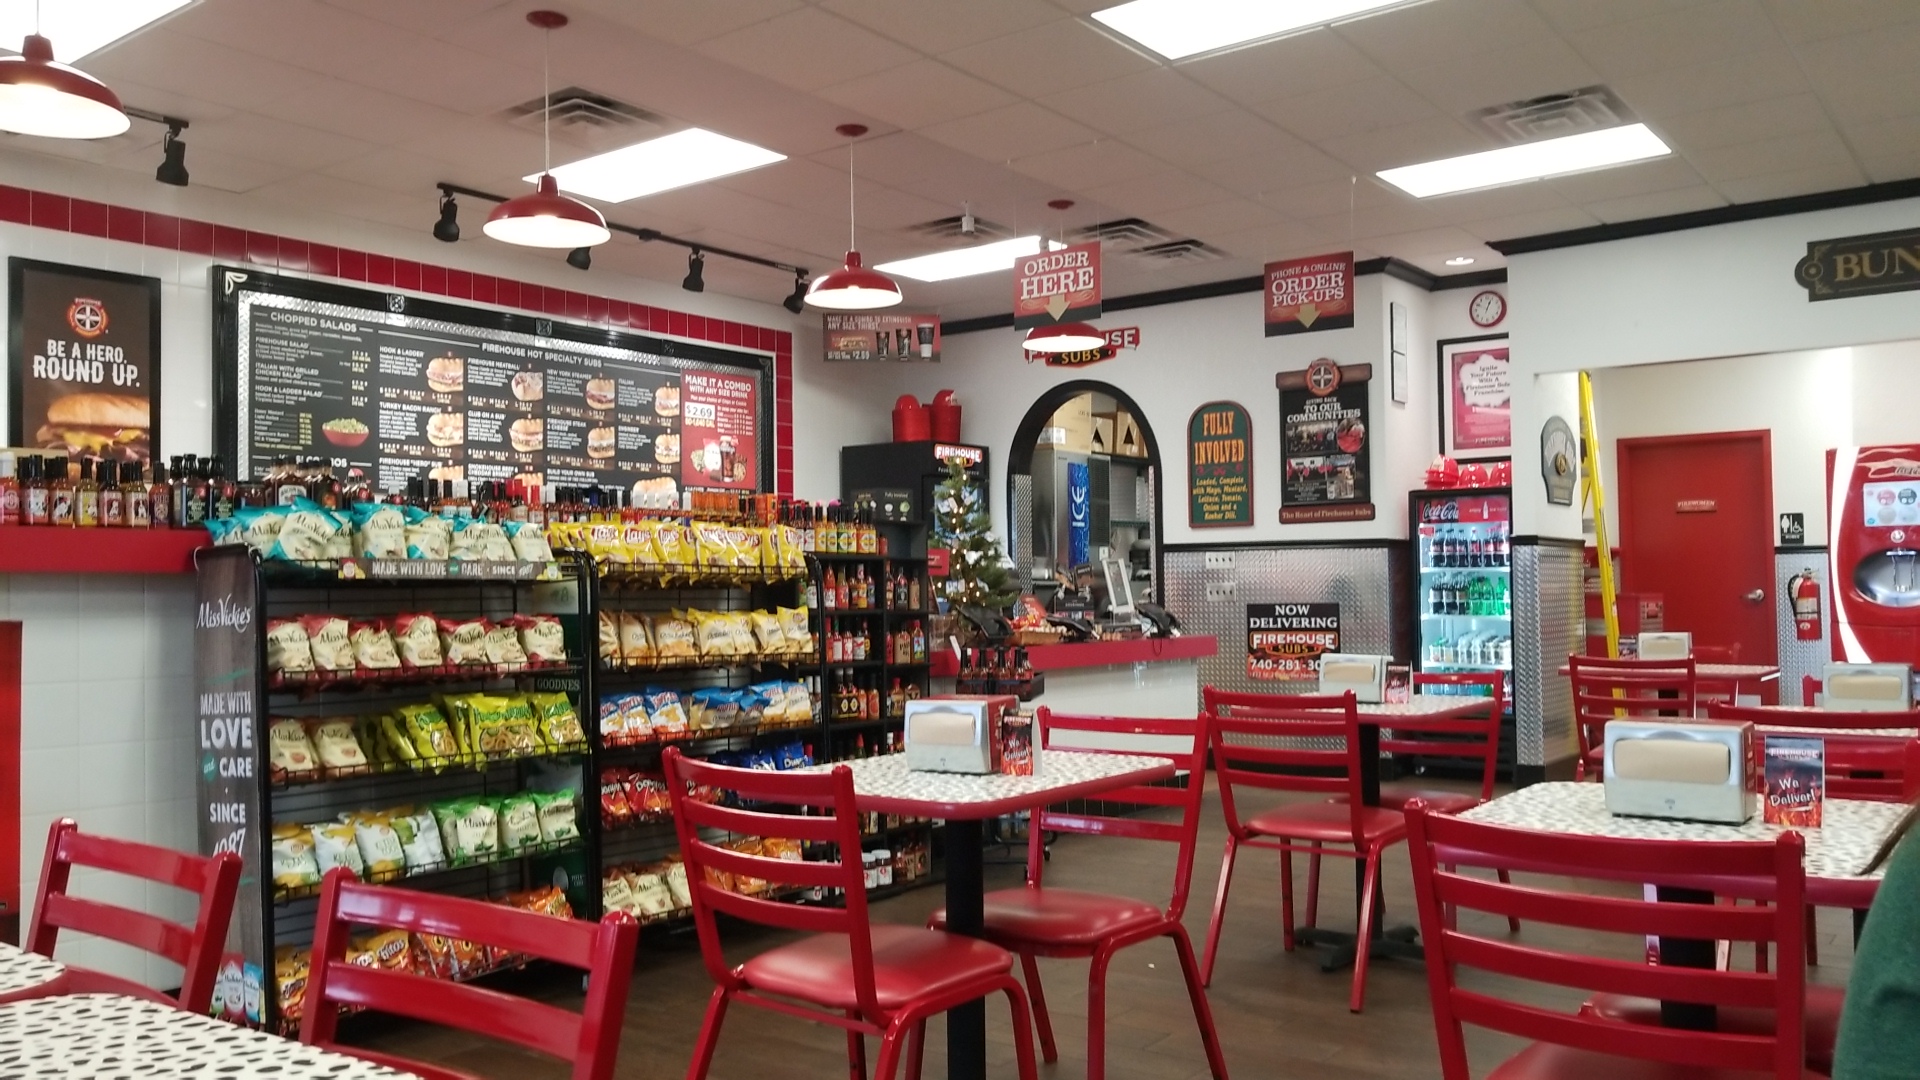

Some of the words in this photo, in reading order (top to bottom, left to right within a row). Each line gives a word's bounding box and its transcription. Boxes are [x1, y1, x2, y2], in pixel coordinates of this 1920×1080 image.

[1024, 251, 1089, 276] ORDER
[1271, 266, 1301, 280] PHONE
[1310, 262, 1346, 272] ONLINE
[1021, 267, 1094, 300] HERE
[1272, 272, 1344, 295] ORDER
[1272, 287, 1344, 307] PICK-UPS
[270, 312, 317, 327] CHOPPED
[320, 319, 357, 333] SALADS
[828, 322, 840, 330] ANY
[256, 336, 288, 346] FIREHOUSE
[47, 339, 66, 357] BE
[72, 342, 81, 360] A
[86, 344, 128, 364] HERO.
[380, 346, 396, 354] HOOK
[402, 349, 424, 358] LADDER
[482, 342, 526, 356] FIREHOUSE
[528, 349, 542, 359] HOT
[544, 352, 582, 365] SPECIALTY
[584, 357, 602, 368] SUBS
[1061, 348, 1100, 364] SUBS
[256, 362, 278, 370] ITALIAN
[295, 367, 319, 376] GRILLED
[468, 358, 494, 367] FIREHOUSE
[33, 355, 104, 384] ROUND
[112, 364, 140, 388] UP.
[685, 374, 707, 386] MAKE
[710, 378, 716, 387] IT
[717, 379, 723, 388] A
[724, 380, 751, 392] COMBO
[690, 385, 704, 393] WITH
[705, 387, 717, 395] ANY
[732, 391, 748, 399] DRINK
[1287, 408, 1361, 424] COMMUNITIES
[1304, 404, 1317, 414] TO
[1320, 403, 1342, 412] OUR
[1203, 411, 1234, 436] FULLY
[936, 446, 980, 463] FIREHOUSE
[1194, 439, 1244, 465] INVOLVED
[1220, 476, 1244, 486] Complete
[1193, 486, 1204, 494] with
[1072, 485, 1085, 528] ICE
[1203, 503, 1219, 511] Onion
[1295, 511, 1313, 519] Heart
[1321, 509, 1354, 517] Firehouse
[1423, 501, 1459, 520] Coca-Cola
[1204, 512, 1223, 520] Kosher
[372, 562, 397, 575] MADE
[400, 562, 423, 575] WITH
[425, 563, 446, 575] LOVE
[461, 563, 483, 575] CARE
[492, 566, 515, 574] SINCE
[1275, 605, 1310, 616] NOW
[1250, 617, 1337, 628] DELIVERING
[1253, 634, 1335, 650] FIREHOUSE
[1279, 644, 1308, 653] SUBS
[200, 693, 225, 714] MADE
[227, 690, 252, 712] WITH
[200, 717, 252, 750] LOVE
[219, 757, 252, 778] CARE
[1779, 777, 1799, 790] We
[1770, 789, 1816, 806] Deliver!
[209, 802, 246, 824] SINCE
